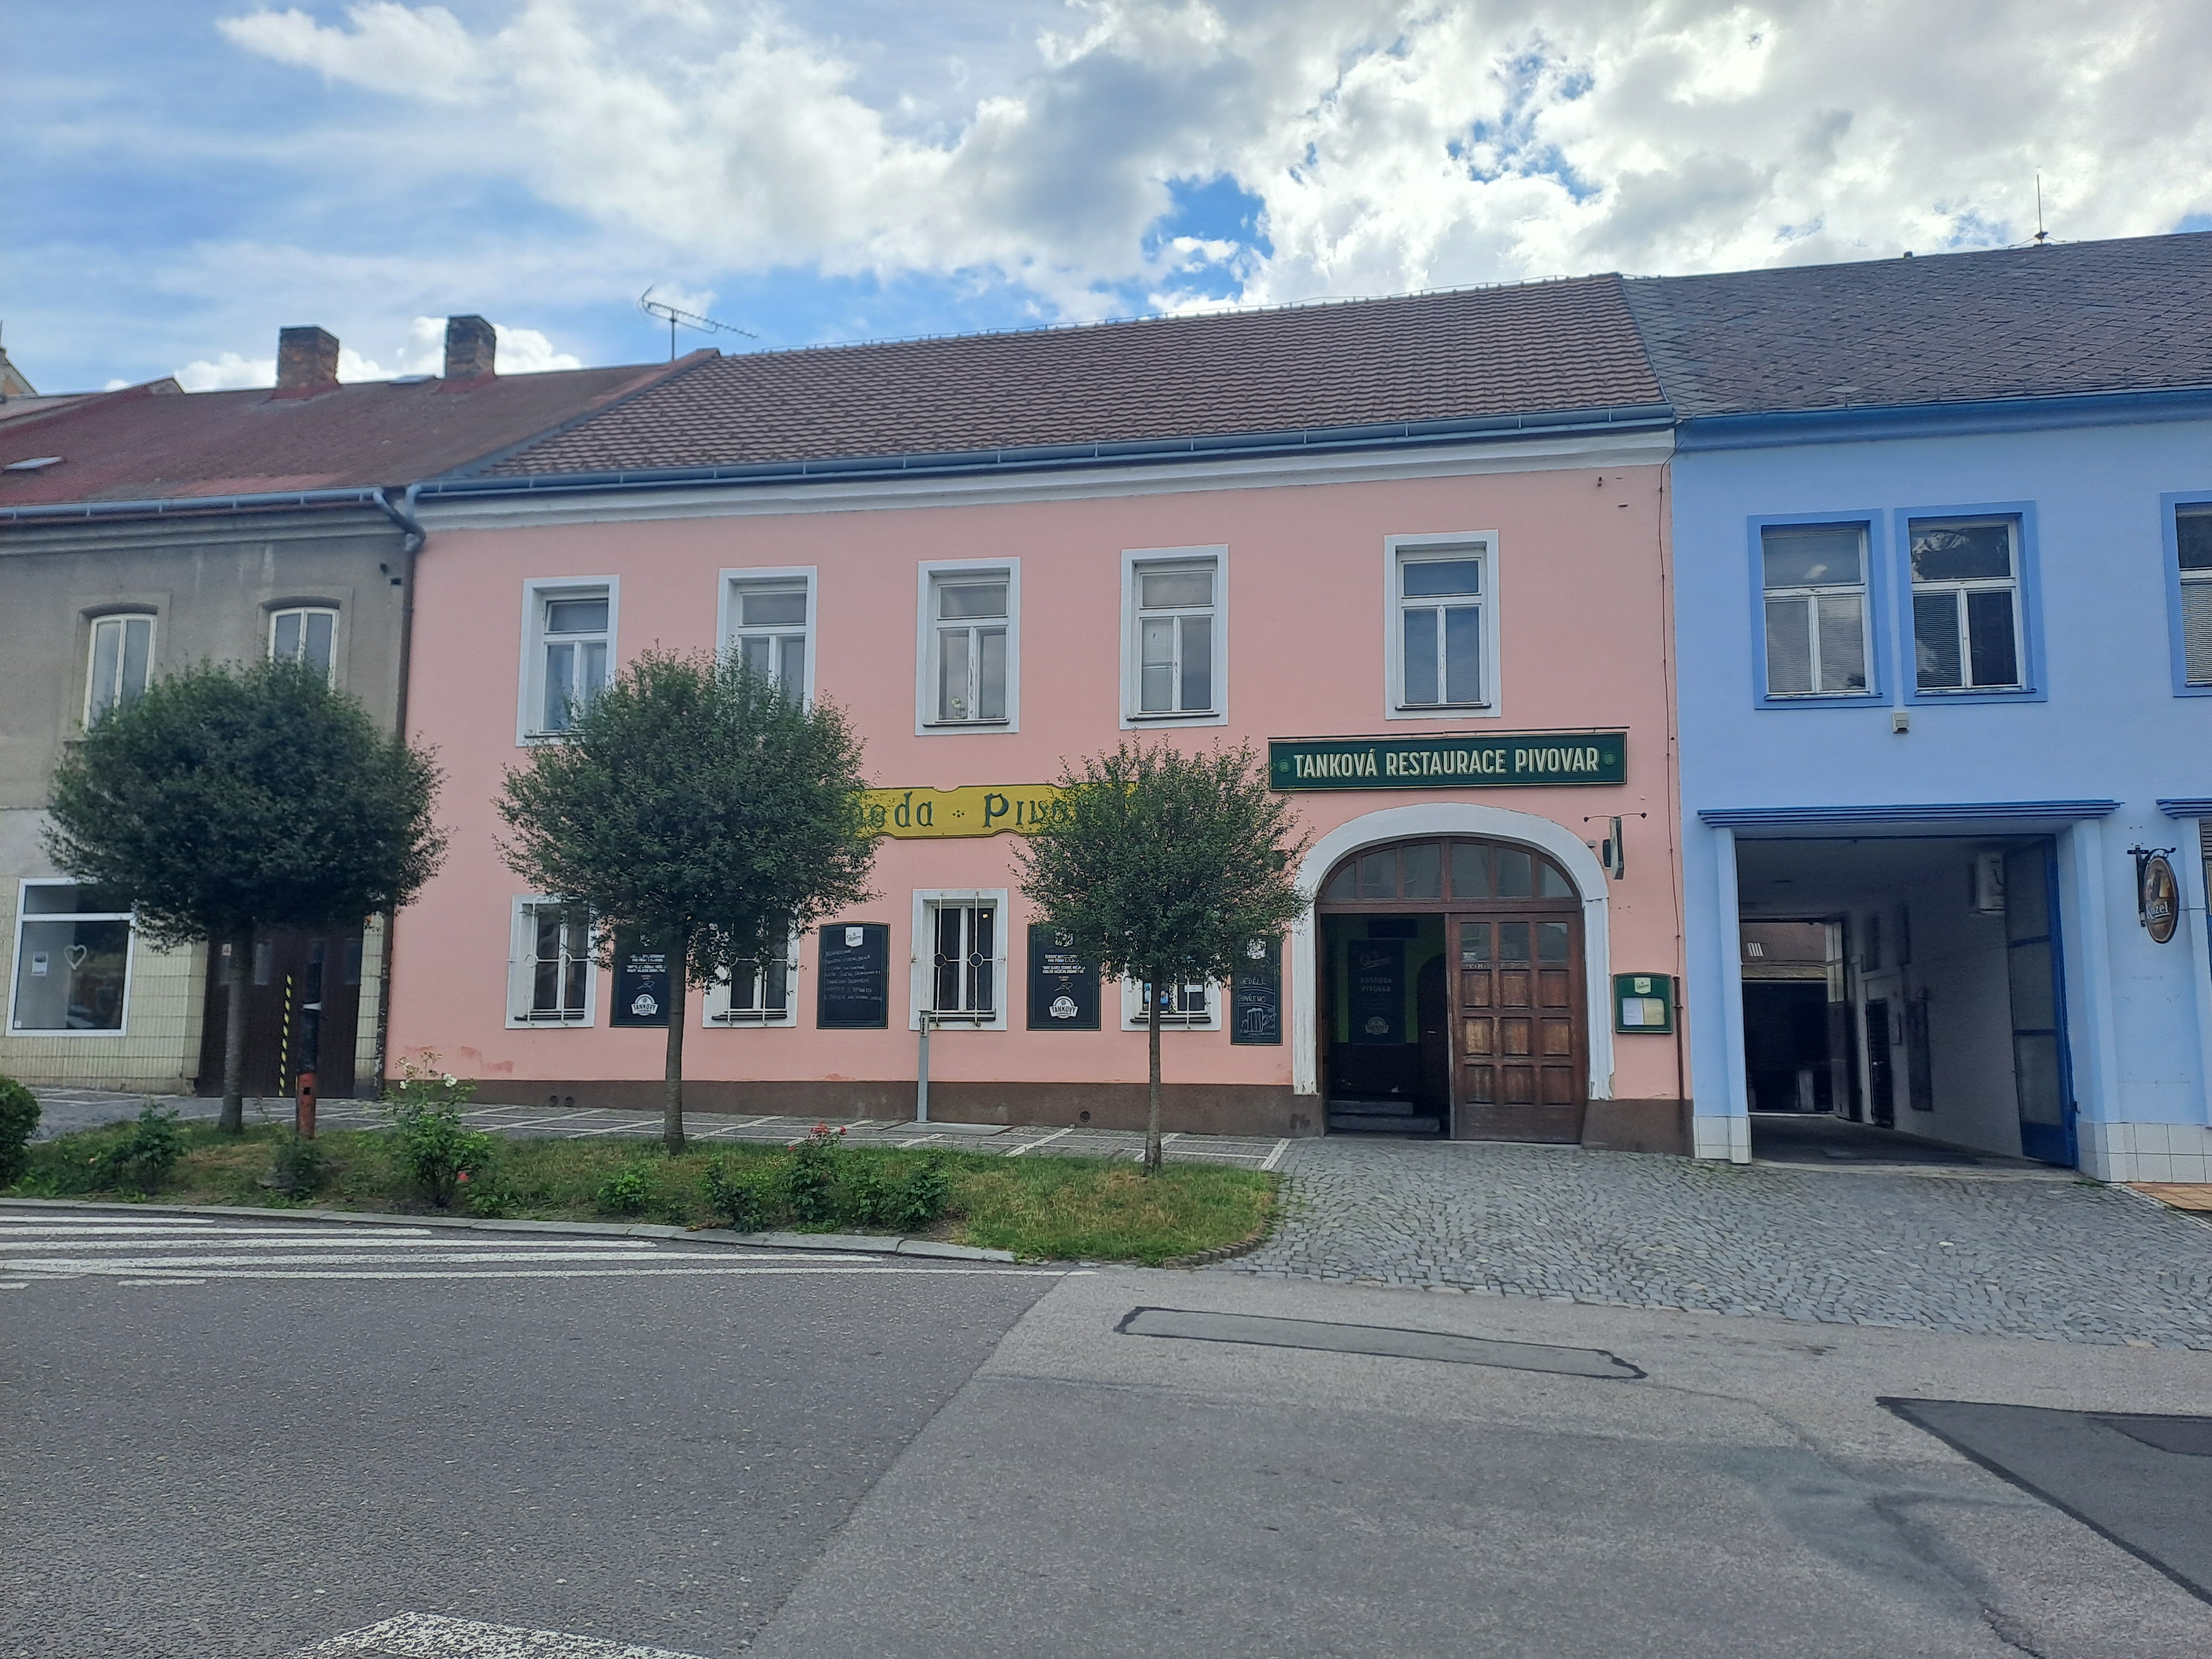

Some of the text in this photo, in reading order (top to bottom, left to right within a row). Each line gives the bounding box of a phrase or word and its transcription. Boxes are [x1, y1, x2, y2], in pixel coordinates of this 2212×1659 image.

[1294, 747, 1600, 778] TANKOVÁ RESTAURACE PIVOVAR
[2146, 901, 2169, 920] Kozel
